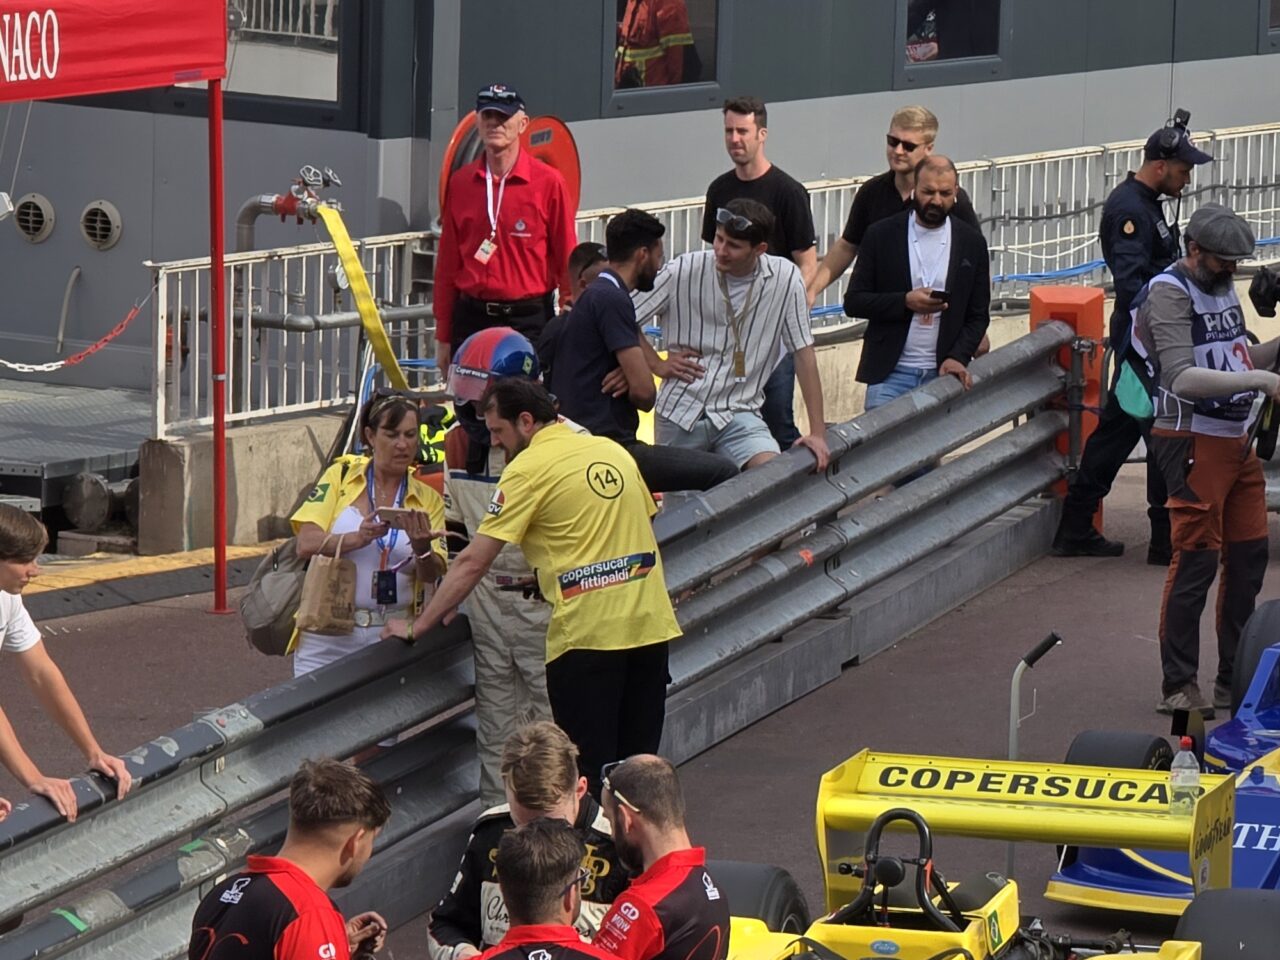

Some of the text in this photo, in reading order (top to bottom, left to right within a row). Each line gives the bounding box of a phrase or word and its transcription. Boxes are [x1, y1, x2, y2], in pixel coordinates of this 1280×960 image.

[593, 468, 618, 490] 14
[561, 556, 629, 584] copersucar
[579, 569, 630, 591] fittipaldi
[620, 901, 640, 921] GD
